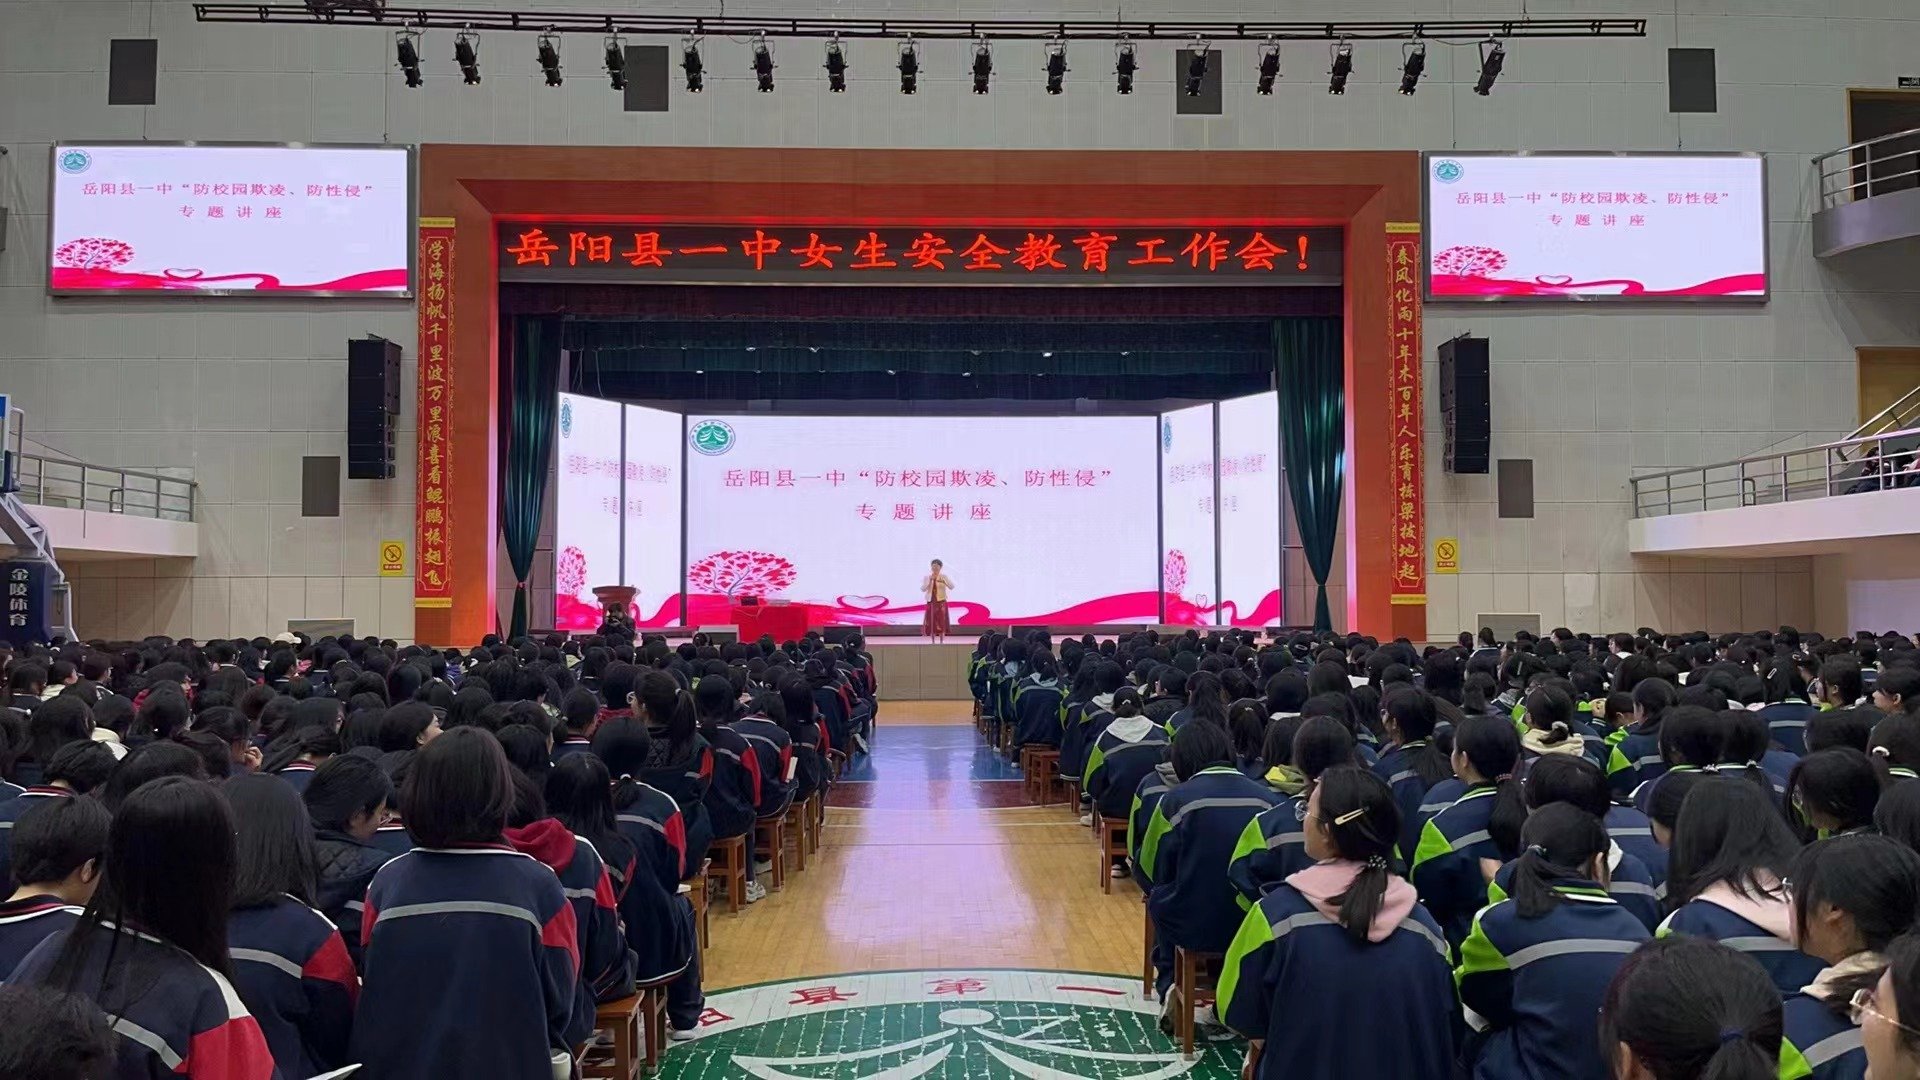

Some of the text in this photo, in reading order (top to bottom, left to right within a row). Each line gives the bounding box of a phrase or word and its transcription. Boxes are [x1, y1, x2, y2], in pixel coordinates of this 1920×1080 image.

[723, 468, 1112, 489] 岳阳县一中“防校园欺凌、防性侵”
[855, 502, 992, 522] 专题讲座
[10, 568, 29, 627] 金陵体育
